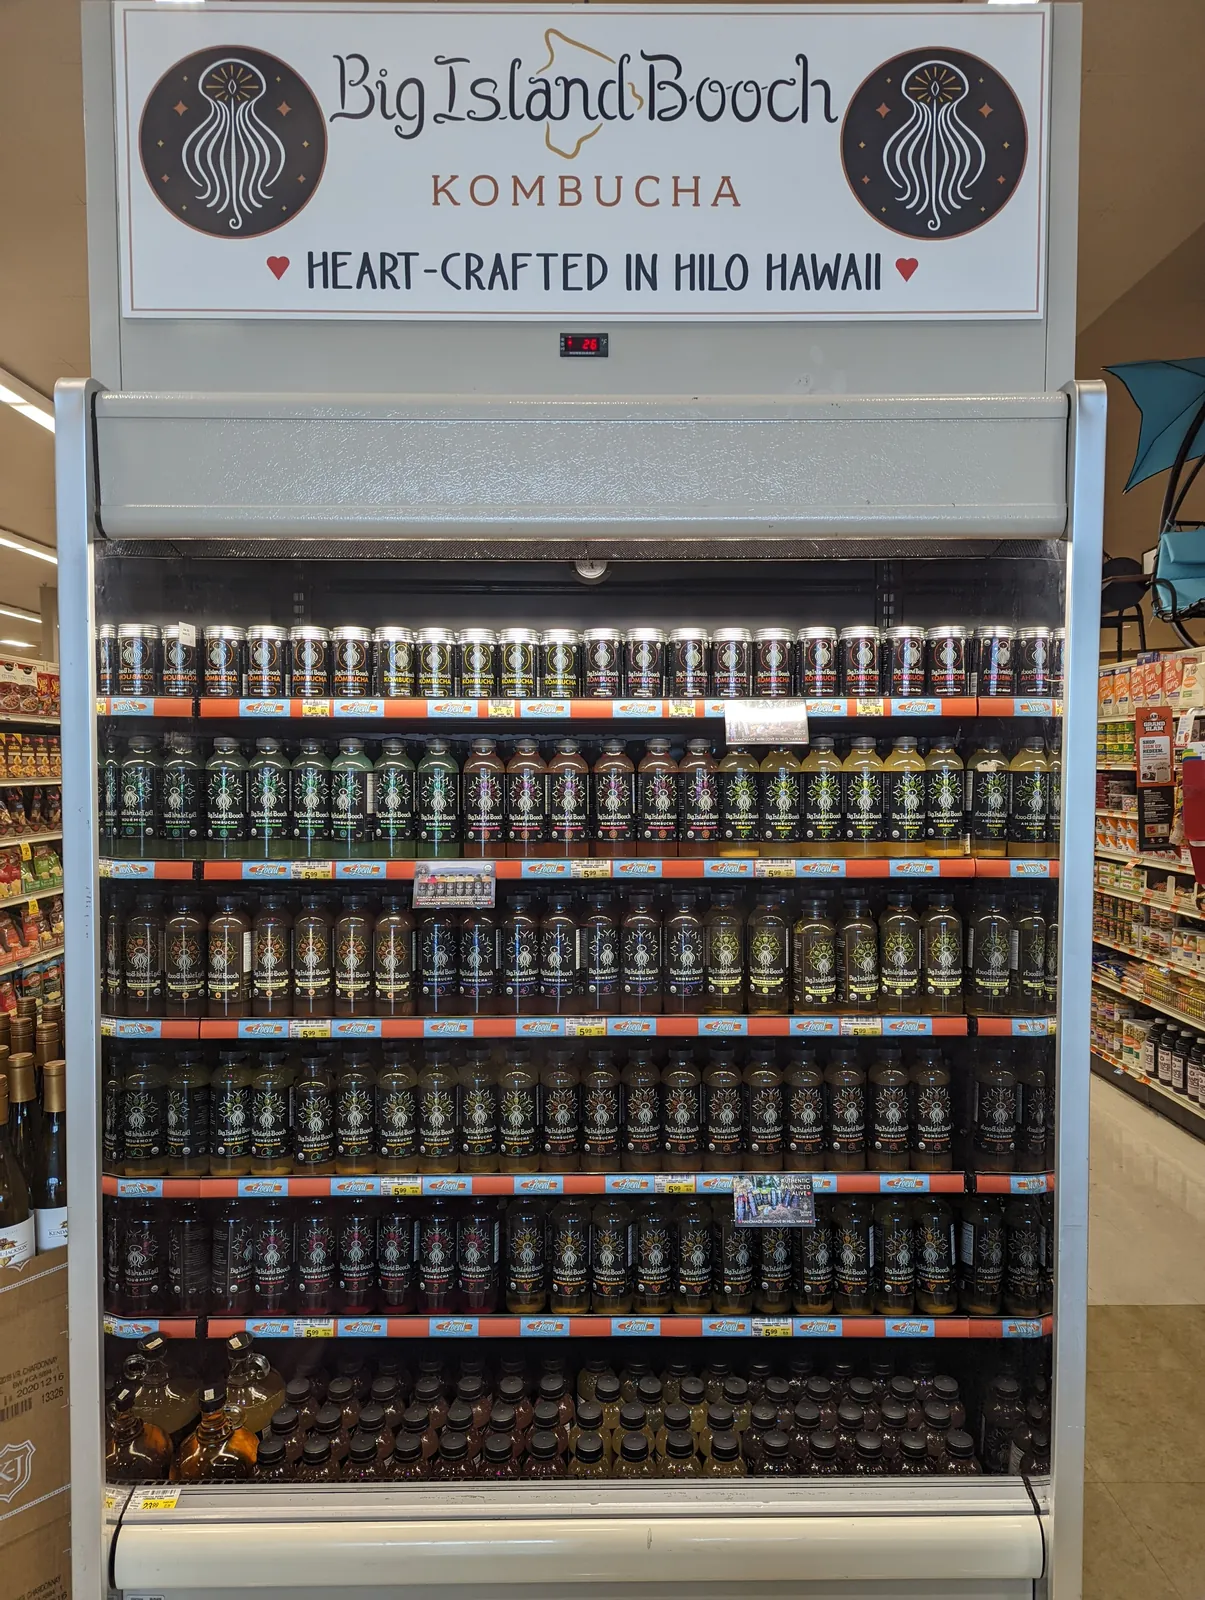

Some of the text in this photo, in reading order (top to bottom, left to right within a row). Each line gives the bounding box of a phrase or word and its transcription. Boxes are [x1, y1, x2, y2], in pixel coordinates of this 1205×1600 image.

[329, 49, 839, 139] Big Island Booch
[431, 174, 742, 208] KOMBUCHA
[307, 250, 881, 292] HEART-CRAFTED IN HILO HAWAII
[292, 674, 327, 682] KOMBUCHA
[42, 1386, 64, 1404] 13326
